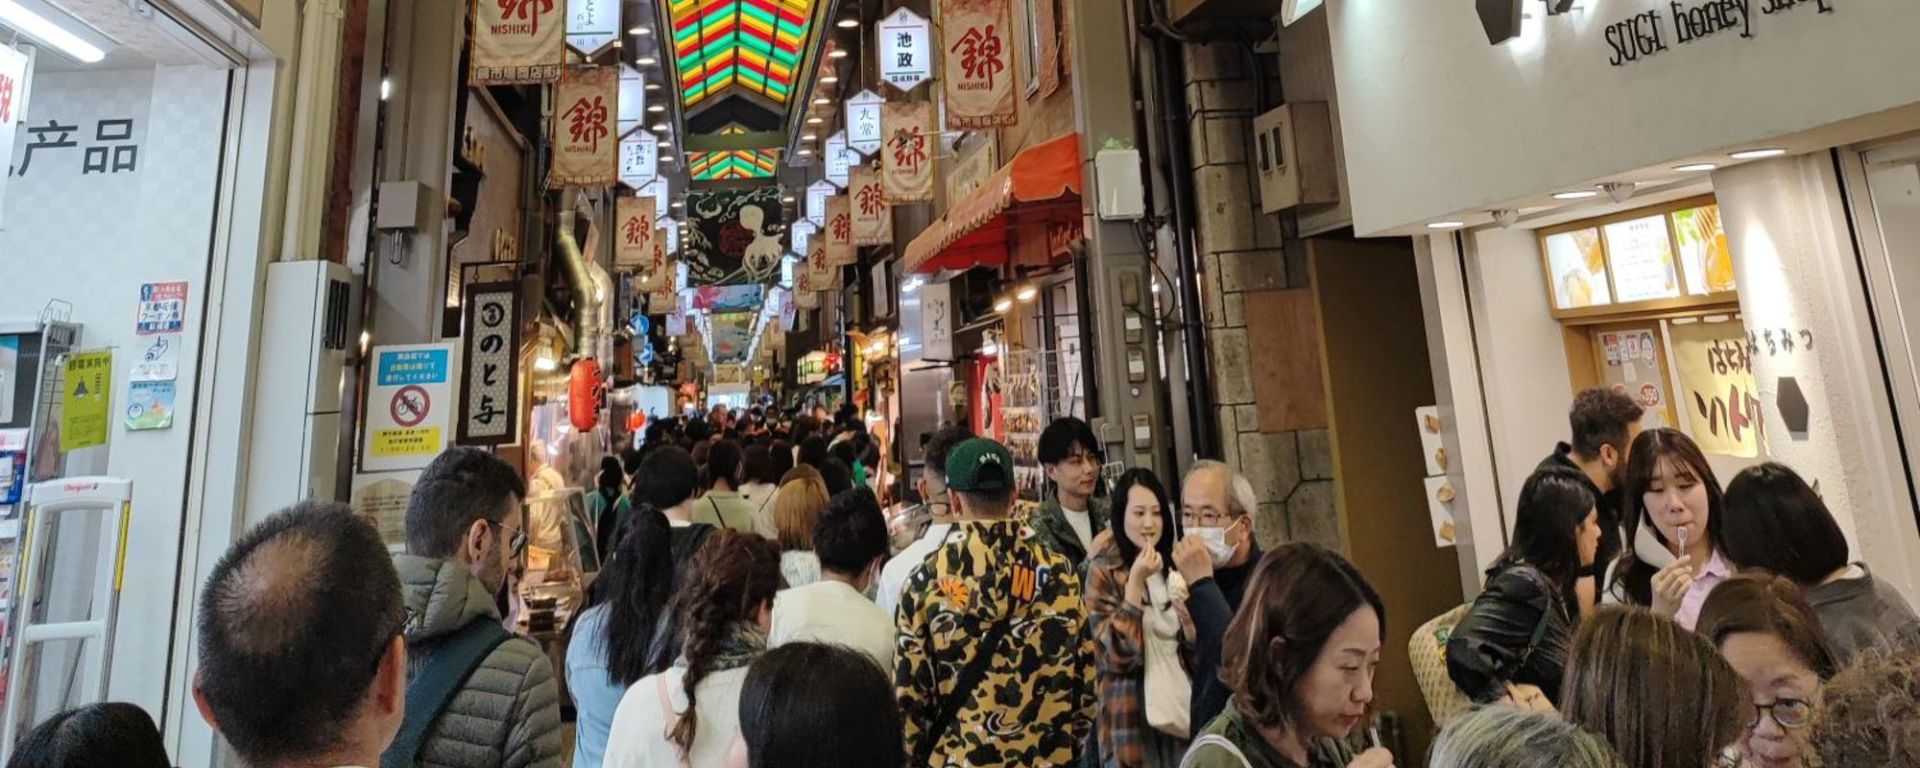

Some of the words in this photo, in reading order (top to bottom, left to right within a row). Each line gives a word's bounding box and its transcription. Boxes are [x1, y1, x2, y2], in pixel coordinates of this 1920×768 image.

[490, 24, 531, 36] NISHIKI
[896, 32, 913, 68] 池政
[1604, 10, 1668, 67] SUGI
[951, 24, 1004, 93] 錦
[957, 81, 989, 92] NISHIKI
[561, 95, 609, 155] 錦
[8, 118, 139, 178] 产品
[854, 182, 885, 222] 錦
[620, 214, 651, 253] 錦
[1745, 328, 1813, 357] はちみつ
[473, 333, 505, 426] のと与
